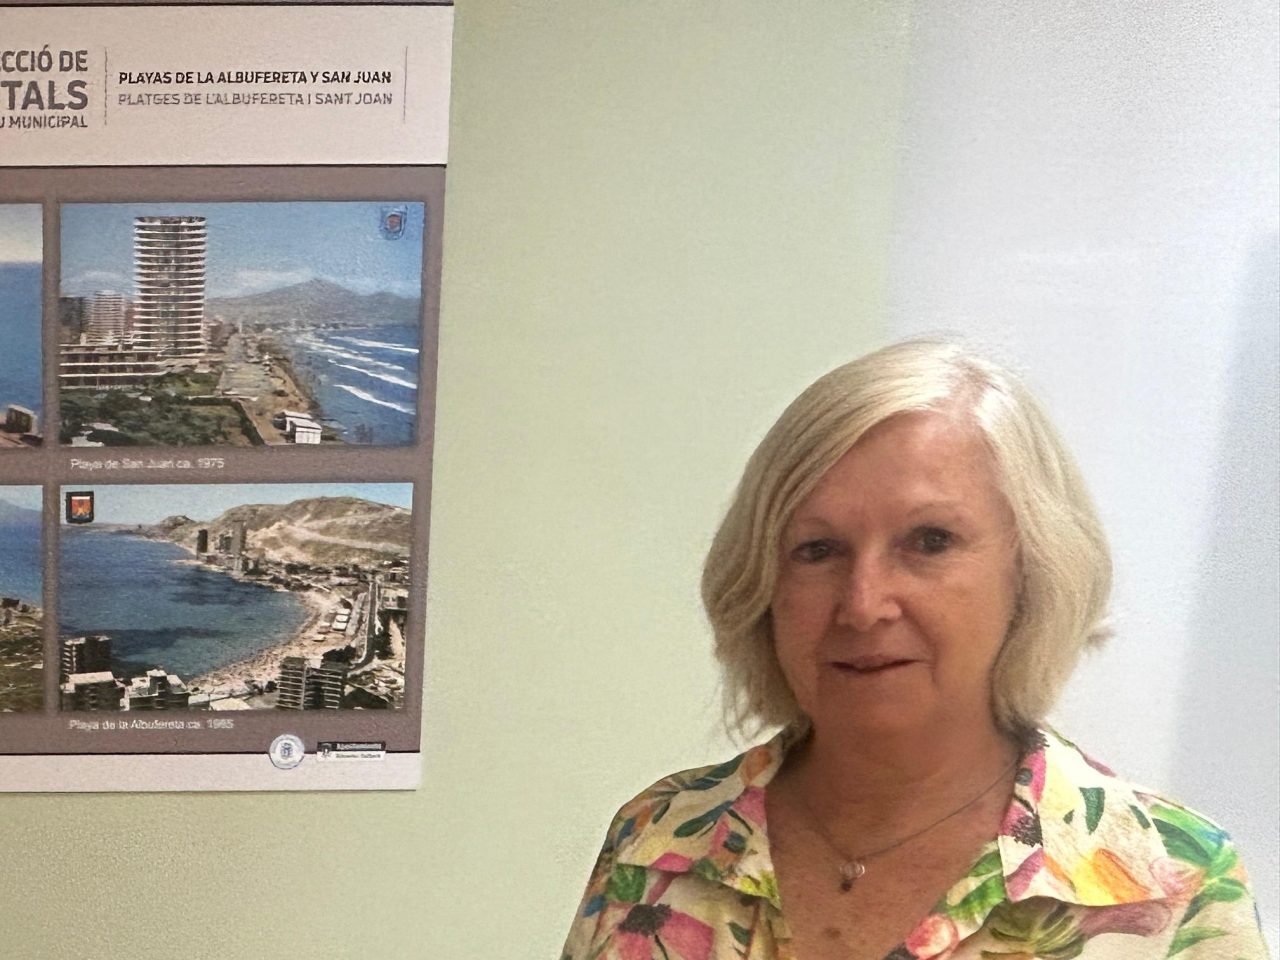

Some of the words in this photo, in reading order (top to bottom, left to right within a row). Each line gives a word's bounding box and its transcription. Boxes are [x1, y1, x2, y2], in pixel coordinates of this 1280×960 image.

[59, 50, 88, 72] DE
[119, 71, 172, 84] PLAYAS
[175, 71, 194, 83] DE
[198, 71, 214, 83] LA
[217, 71, 307, 83] ALBUFERETA
[310, 71, 319, 83] Y
[322, 71, 351, 83] SAN
[354, 71, 392, 83] JUAN
[118, 93, 180, 105] PLATGES
[183, 93, 202, 104] DE
[206, 93, 305, 105] L'ALBUFERETA
[315, 93, 353, 104] SANT
[355, 93, 393, 104] JOAN
[8, 115, 88, 129] MUNICIPAL
